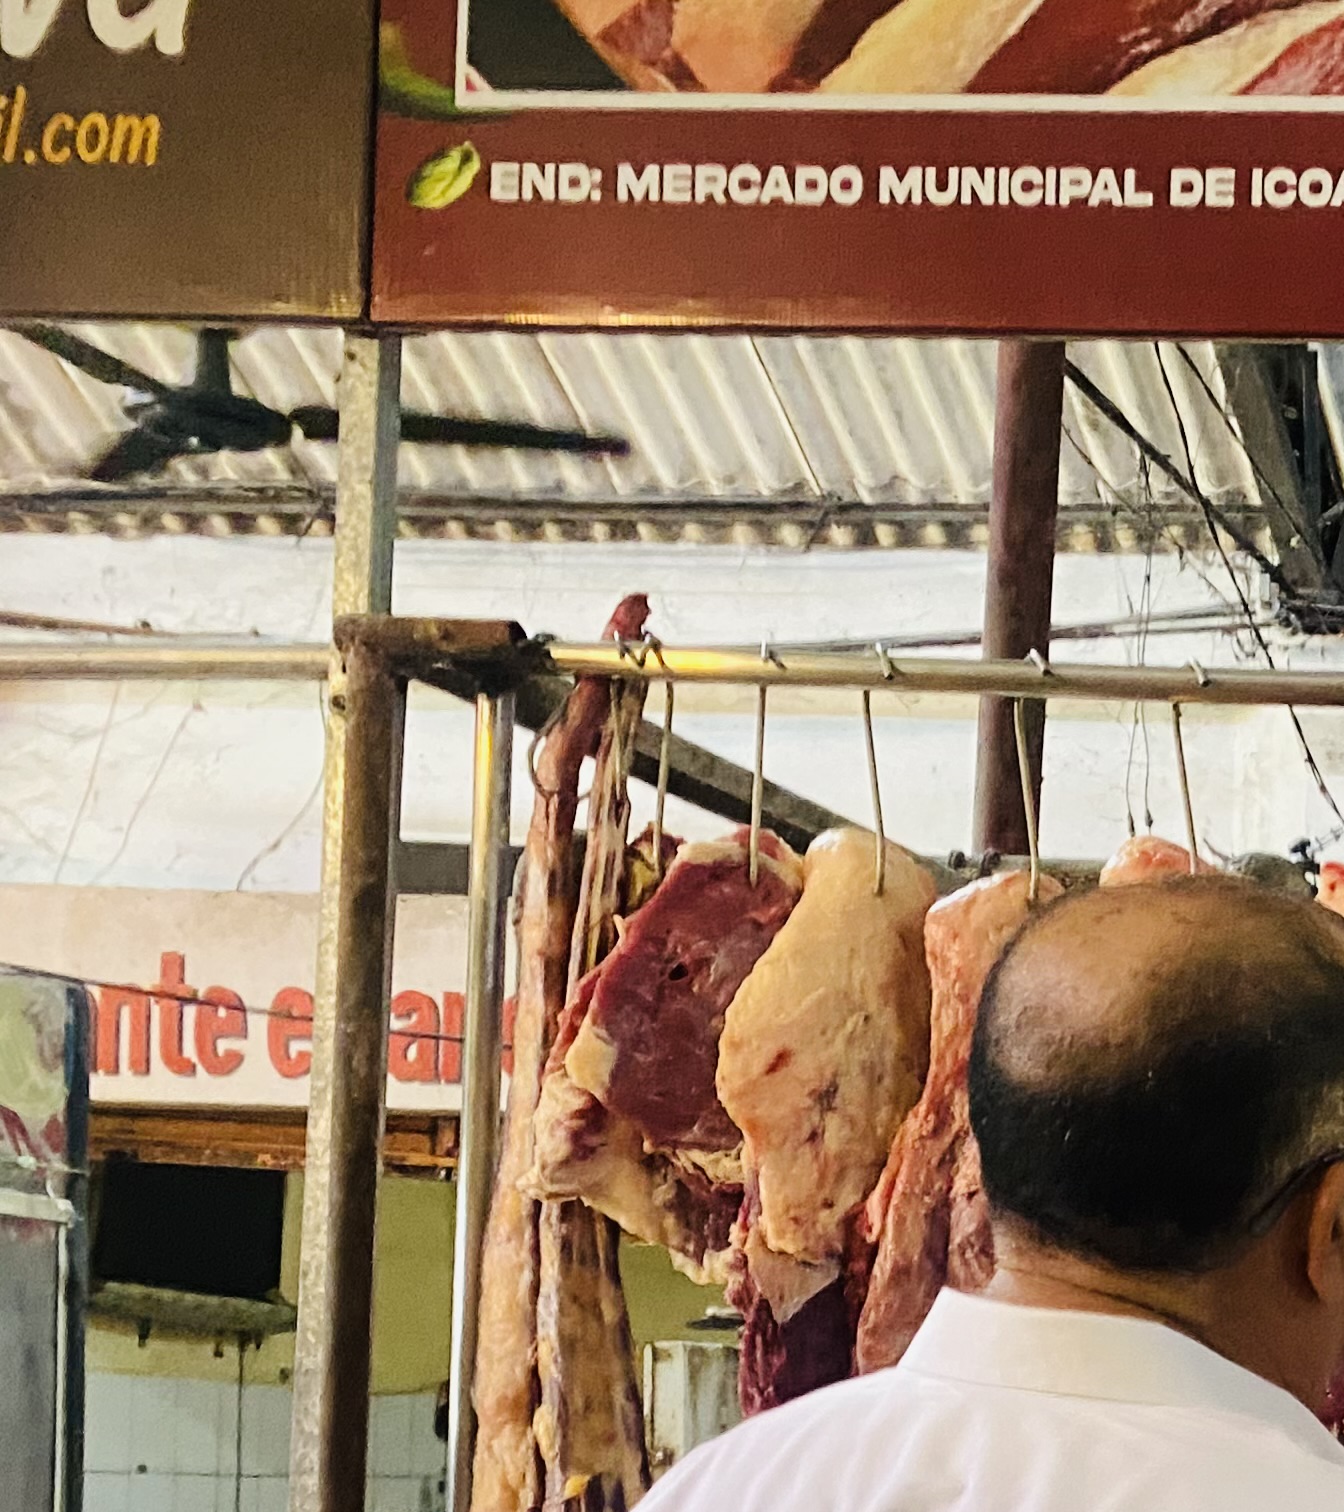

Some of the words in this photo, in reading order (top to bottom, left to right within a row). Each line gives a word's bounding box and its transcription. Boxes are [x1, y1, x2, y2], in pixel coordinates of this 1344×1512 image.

[490, 162, 602, 202] END:
[616, 163, 863, 206] MERCADO
[878, 165, 1153, 207] MUNICIPAL
[1169, 167, 1236, 208] DE
[88, 951, 247, 1076] nte
